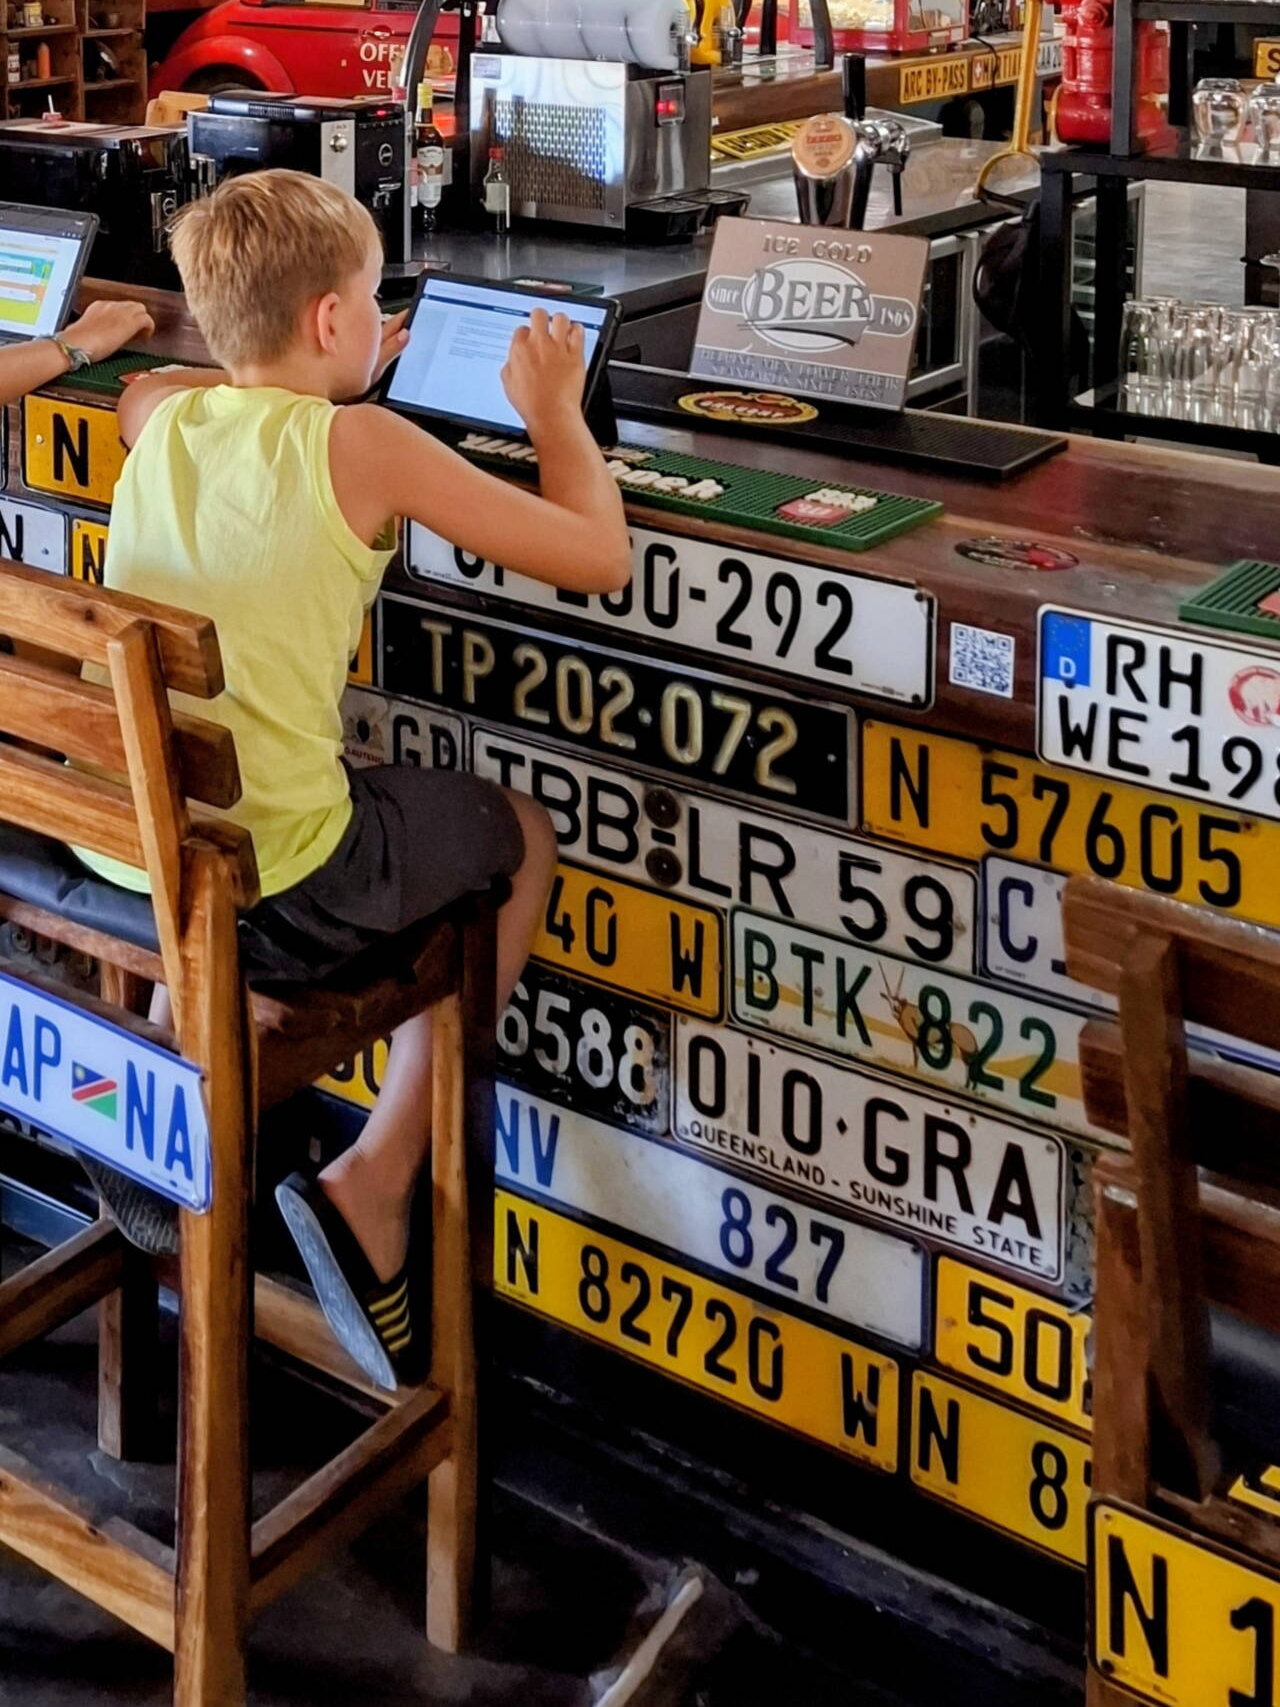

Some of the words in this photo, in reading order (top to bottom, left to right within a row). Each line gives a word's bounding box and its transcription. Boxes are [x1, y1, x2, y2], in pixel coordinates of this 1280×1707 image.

[904, 70, 923, 99] ARC
[926, 62, 966, 93] BY-PASS
[762, 234, 801, 255] ICE
[812, 239, 873, 264] COLD
[710, 283, 740, 304] since
[752, 267, 870, 322] BEER
[880, 306, 911, 327] 1868
[700, 349, 753, 368] HELPING
[764, 354, 792, 374] MEN
[798, 360, 849, 383] LOWER
[858, 373, 900, 391] THEIR
[711, 364, 791, 385] STANDARDS
[795, 378, 834, 393] SINCE
[52, 412, 89, 487] N
[421, 618, 496, 704] TP
[1058, 657, 1077, 679] D
[1106, 633, 1204, 716] RH
[1058, 695, 1150, 777] WE
[486, 744, 641, 866] TBB
[688, 806, 797, 919] LR
[837, 850, 955, 963] 59
[890, 737, 930, 829] N
[980, 759, 1243, 909] 57605
[669, 910, 705, 999] W
[494, 980, 661, 1106] 6588
[743, 927, 873, 1048] BTK
[918, 984, 1059, 1110] 822
[125, 1058, 194, 1182] NA
[688, 1120, 826, 1186] QUEENSLAND
[848, 1180, 958, 1235] SUNSHINE
[971, 1224, 1044, 1268] STATE
[718, 1186, 846, 1304] 827
[505, 1208, 540, 1295] N
[578, 1243, 784, 1398] 82720
[840, 1350, 879, 1447] W
[918, 1389, 961, 1488] N
[1107, 1534, 1170, 1680] N
